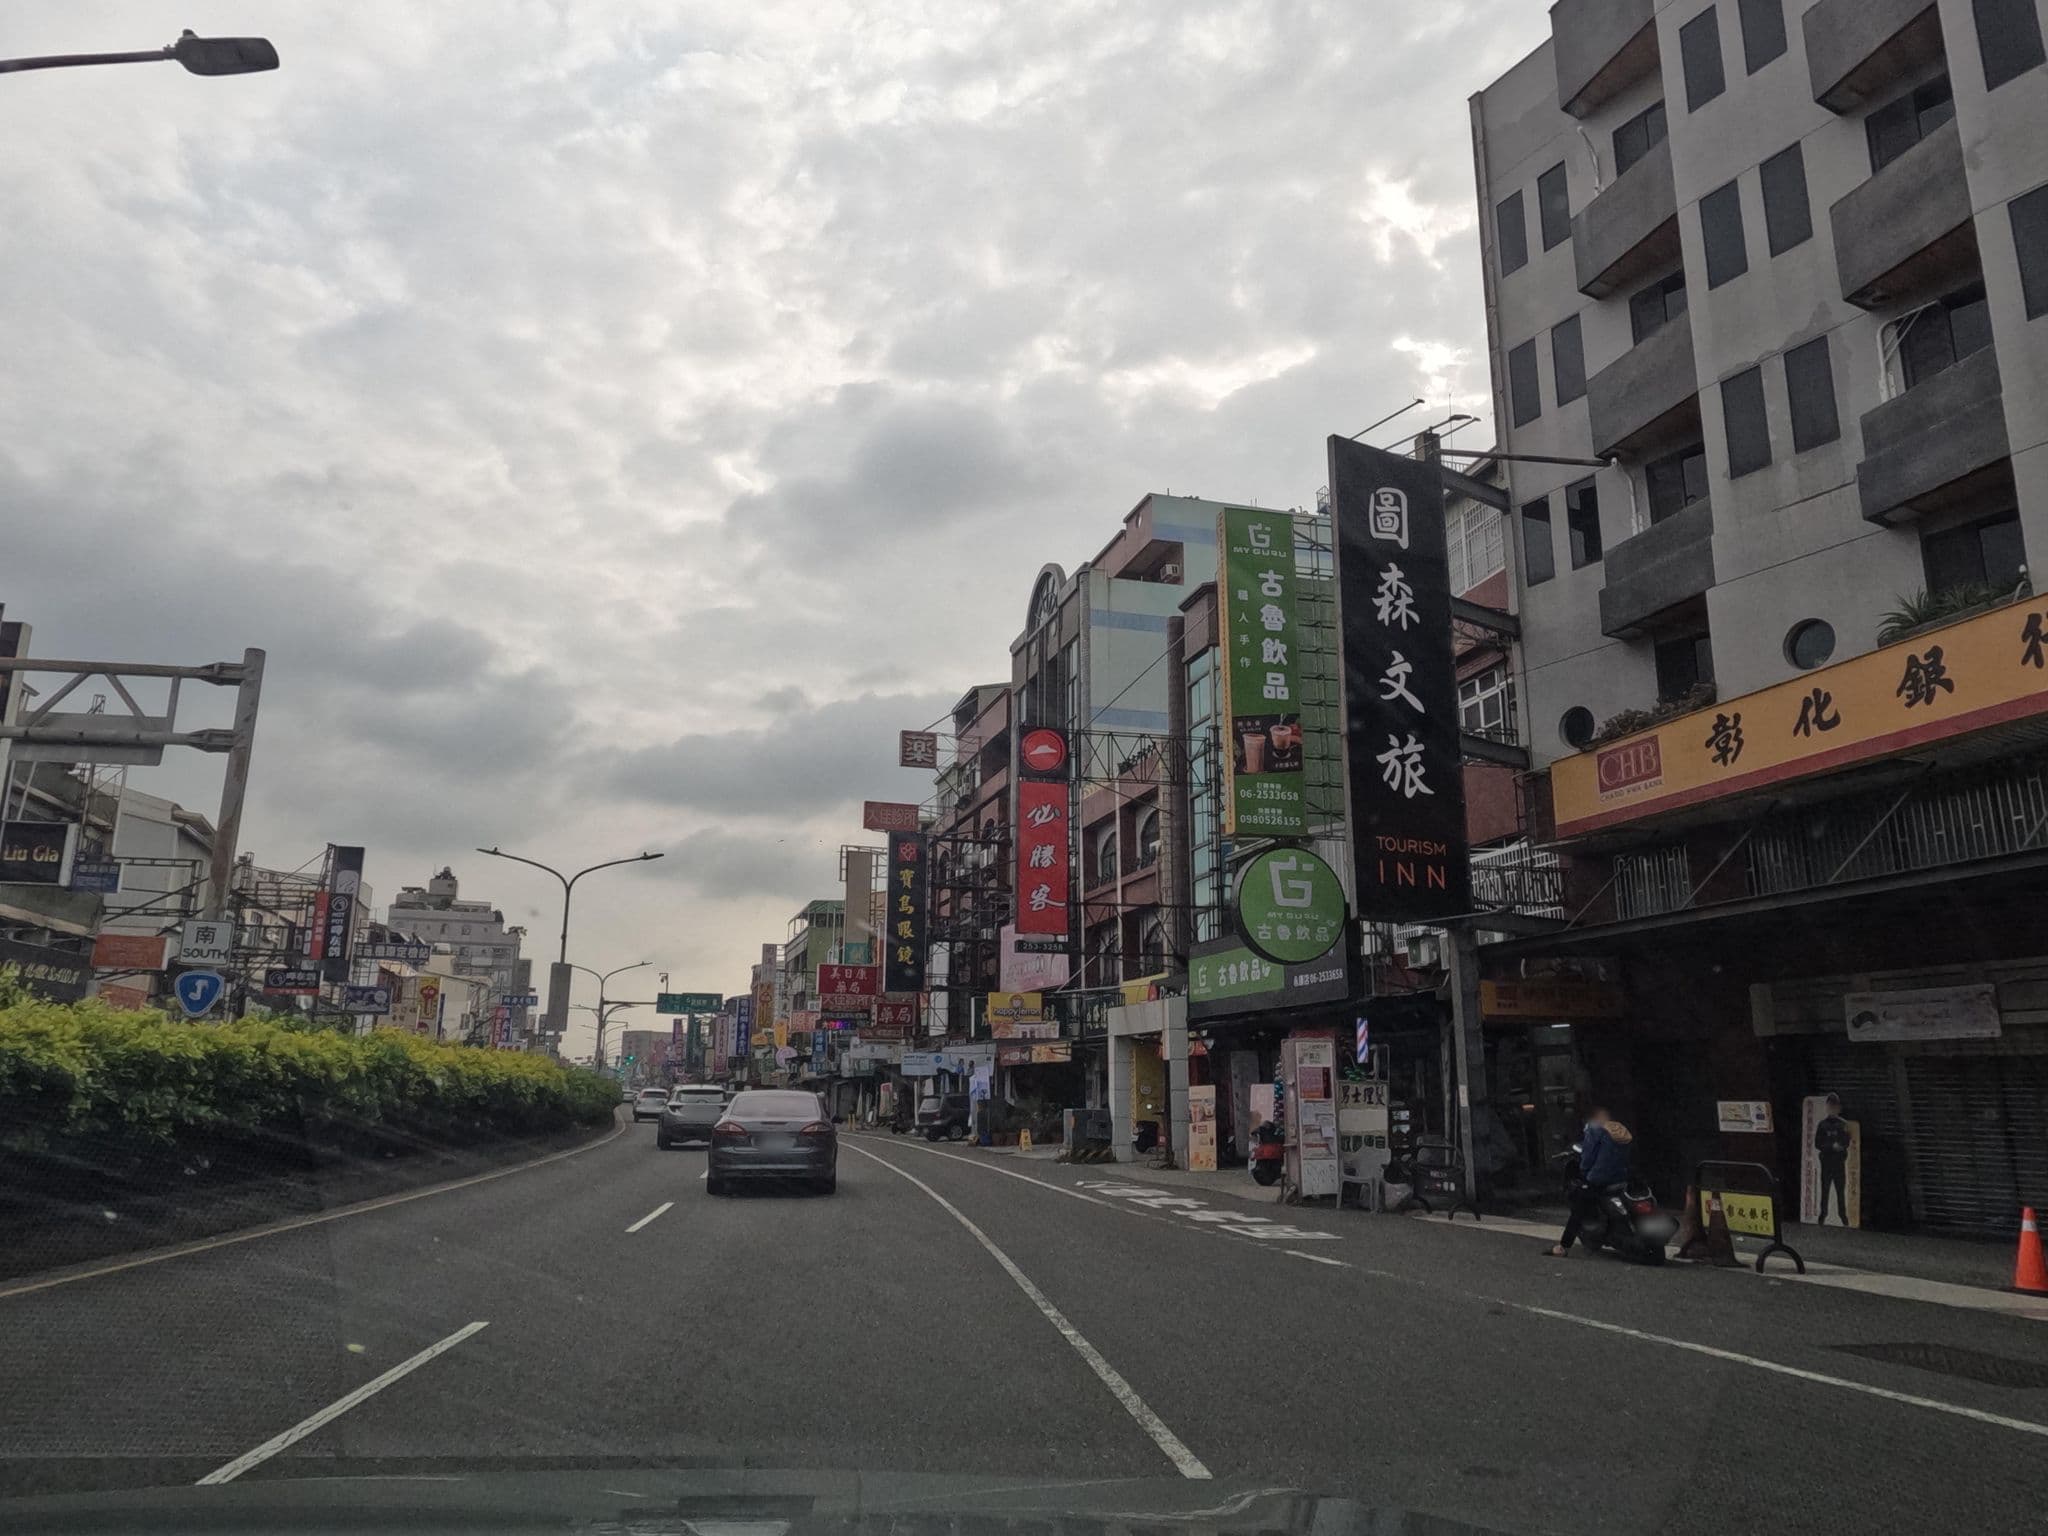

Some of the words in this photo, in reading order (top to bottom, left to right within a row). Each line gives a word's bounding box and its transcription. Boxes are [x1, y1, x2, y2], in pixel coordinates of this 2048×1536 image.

[1233, 546, 1249, 554] MY
[1253, 547, 1287, 558] GURU
[1257, 569, 1290, 700] 古魯飲品
[1369, 487, 1434, 798] 圖森文旅
[1600, 743, 1657, 786] CHB
[1240, 788, 1299, 801] 06-2533658
[1240, 814, 1302, 826] 0980526155
[1026, 802, 1067, 912] 必勝客
[1375, 835, 1447, 857] TOURISM
[1379, 859, 1447, 890] INN
[897, 867, 916, 965] 寶島眼鏡
[195, 926, 217, 945] 南
[1257, 923, 1330, 942] 古魯飲品
[182, 946, 228, 961] SOUTH
[1218, 958, 1260, 986] 古魯飲品
[879, 1007, 912, 1024] 藥局
